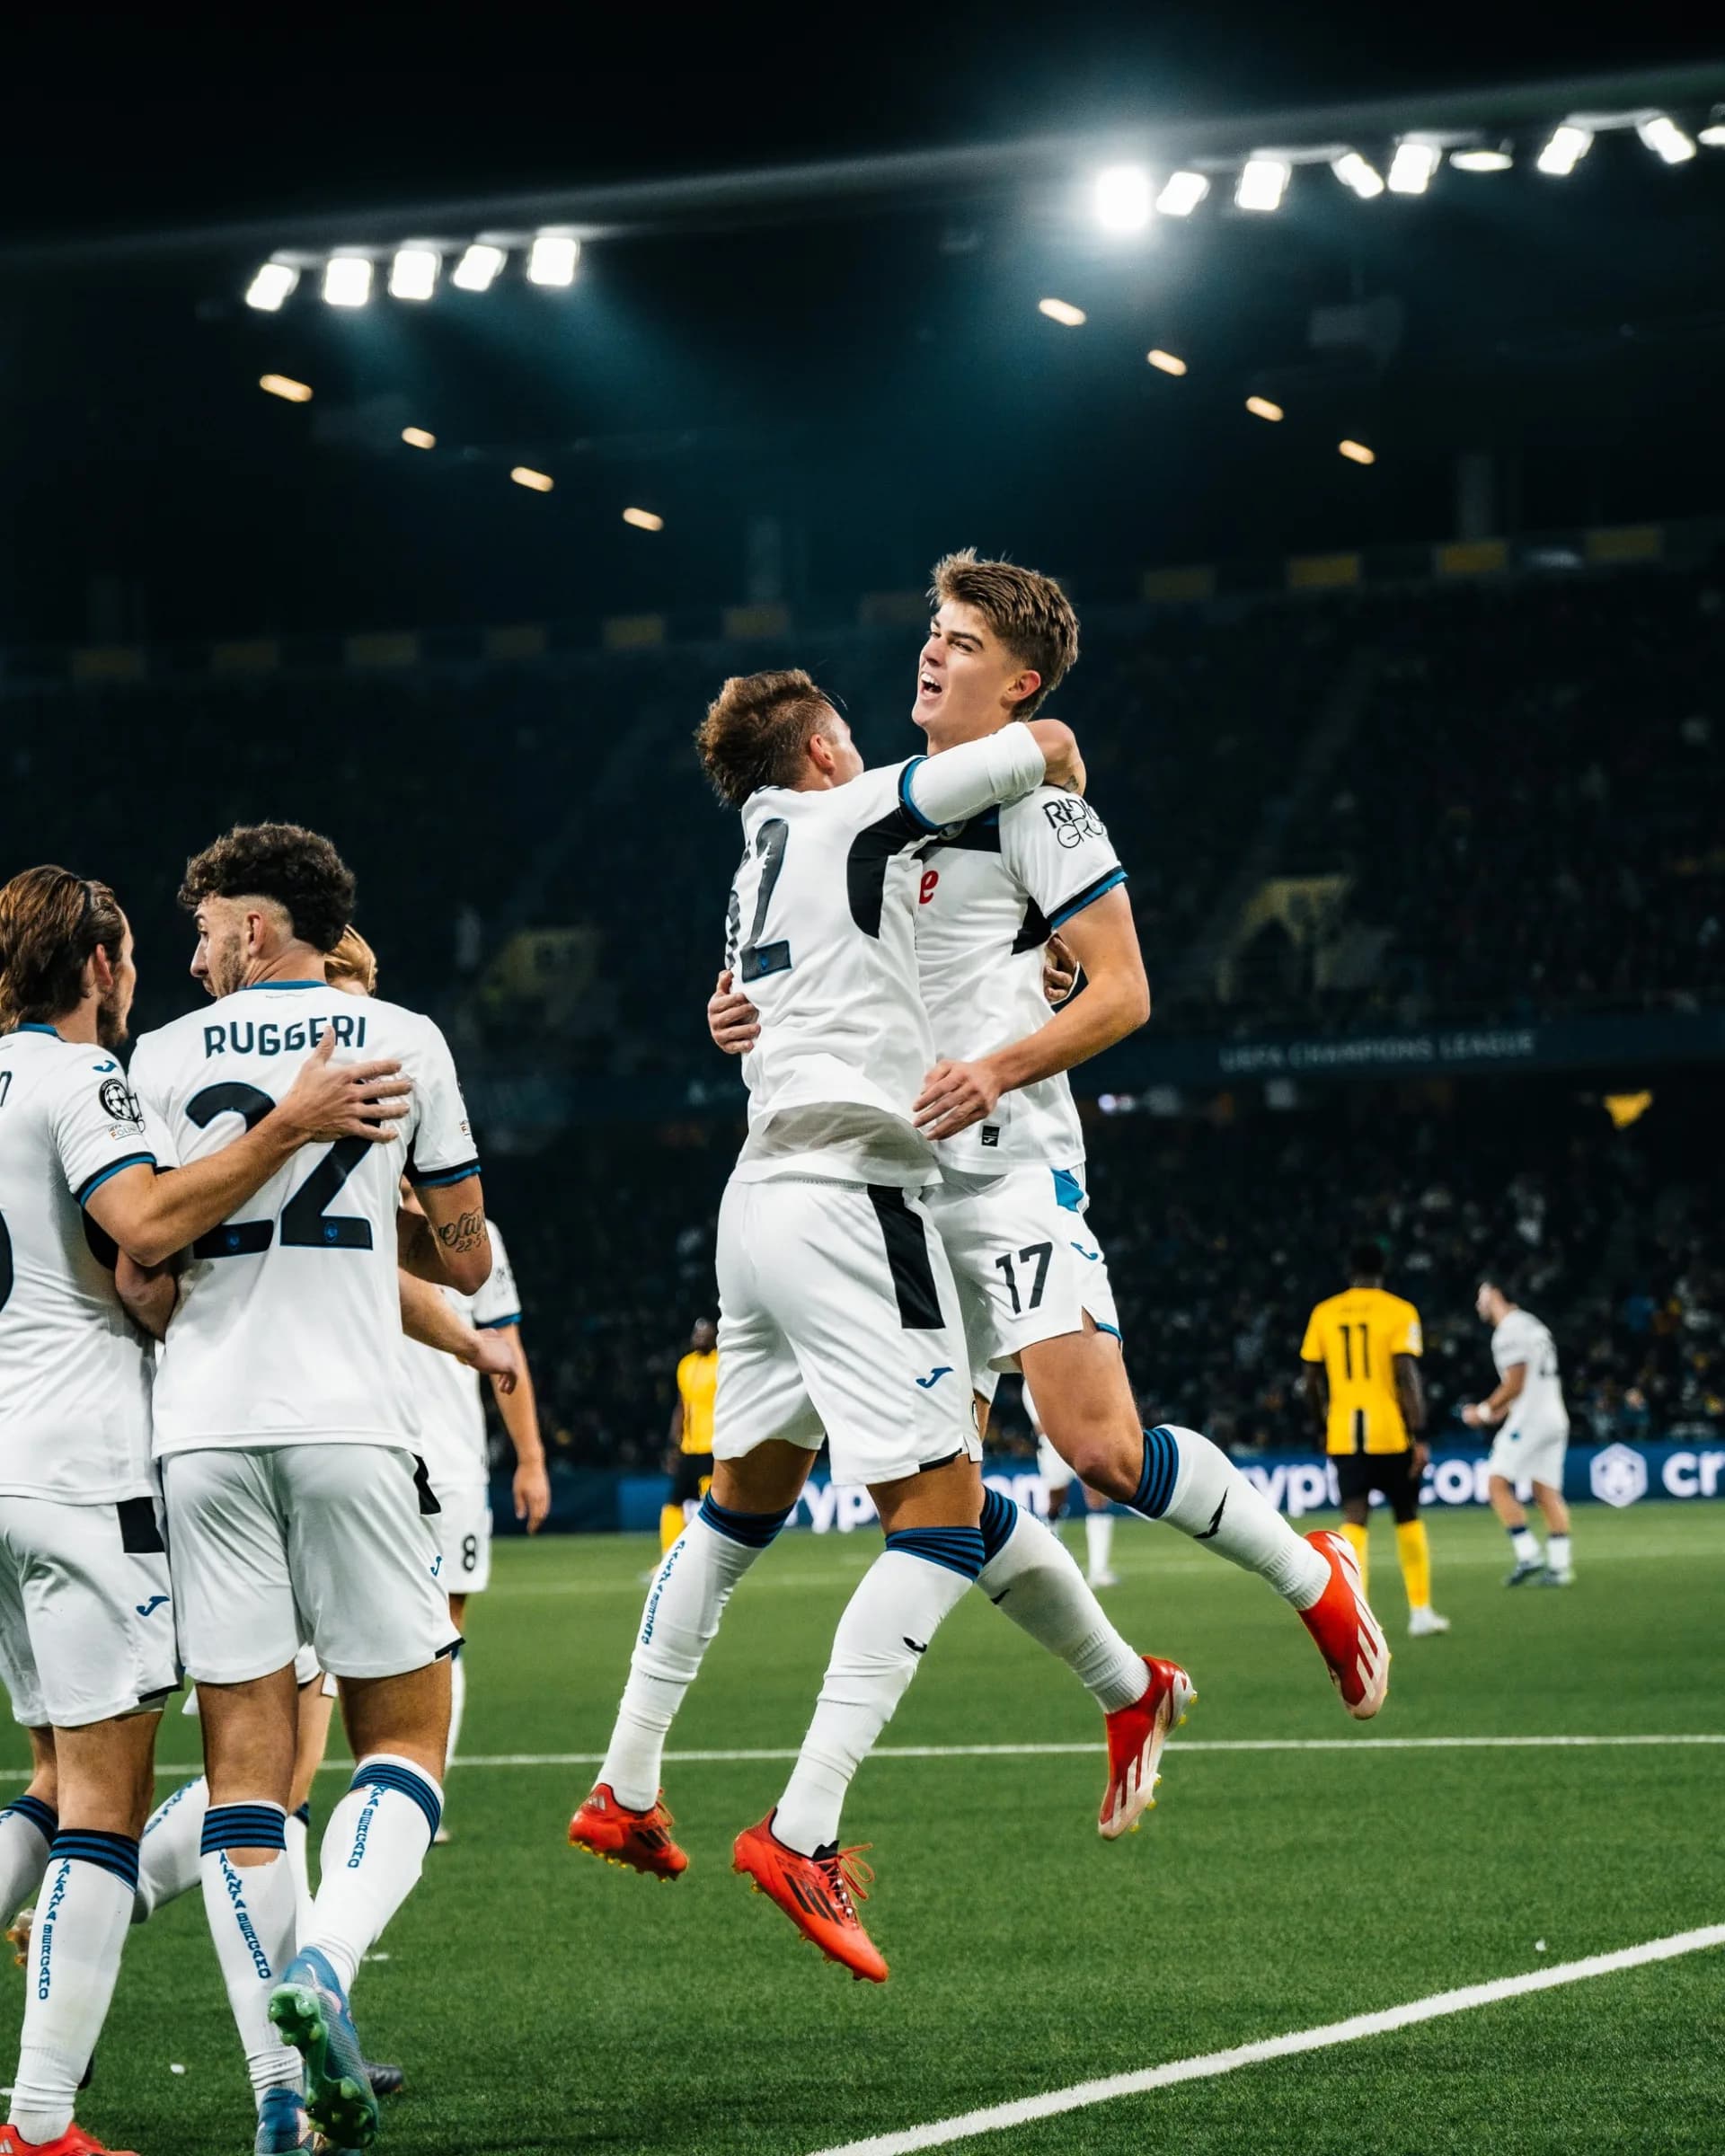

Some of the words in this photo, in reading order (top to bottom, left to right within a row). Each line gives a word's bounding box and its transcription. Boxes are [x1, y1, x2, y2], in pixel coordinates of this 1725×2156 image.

[203, 1015, 367, 1059] RUGGERI
[185, 1081, 382, 1259] 22
[995, 1241, 1053, 1315] 17
[1339, 1322, 1370, 1381] 11
[462, 1533, 477, 1573] 8
[347, 1807, 374, 1869] BERGAMO
[39, 1923, 53, 2001] BERGAMO
[235, 1912, 272, 1980] BERGAMO
